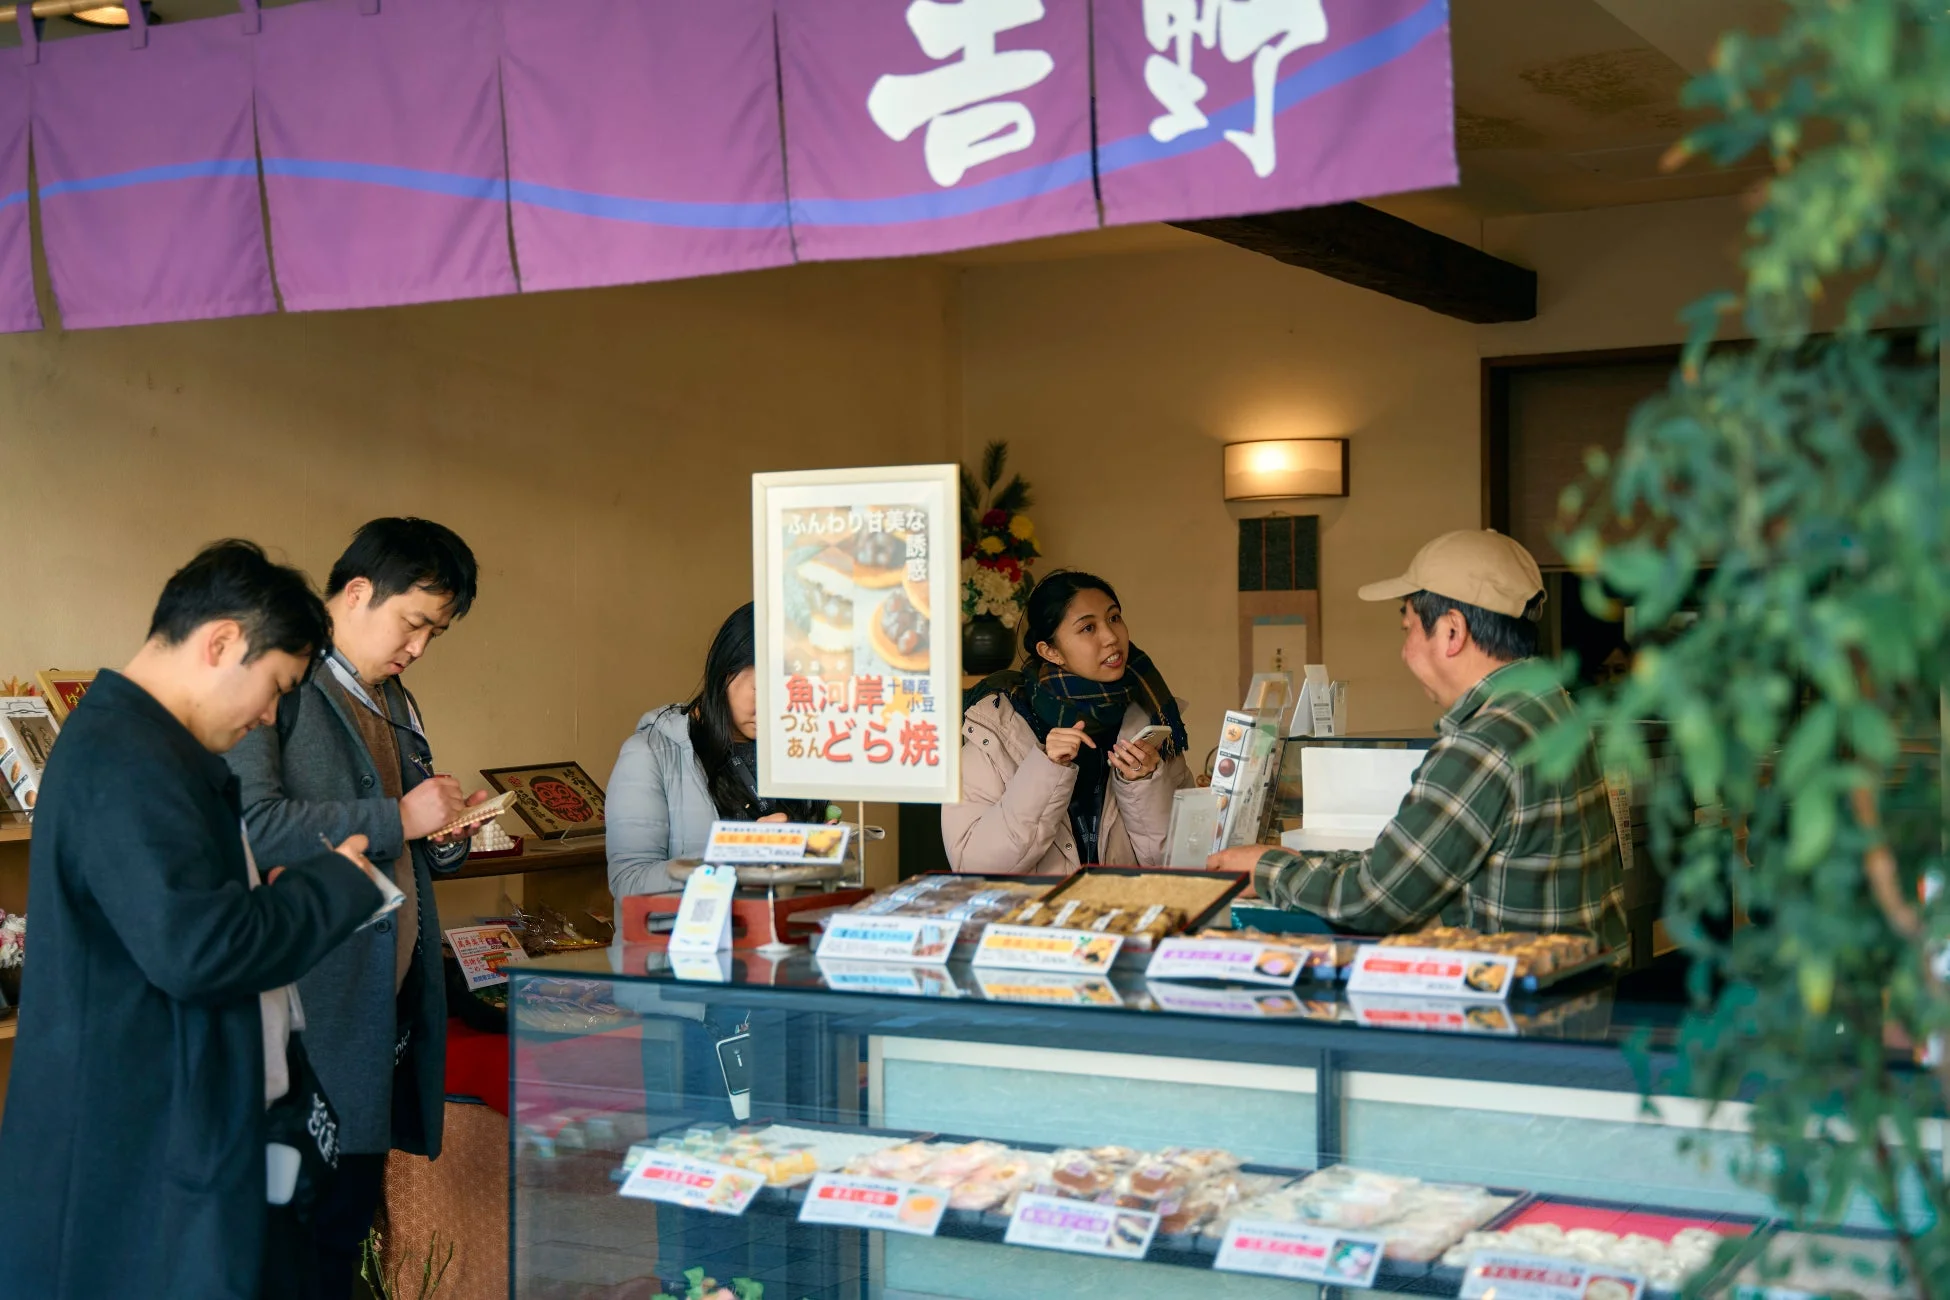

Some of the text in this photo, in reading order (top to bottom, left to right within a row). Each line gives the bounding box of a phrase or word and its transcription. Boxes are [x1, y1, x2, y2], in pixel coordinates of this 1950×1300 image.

[788, 509, 926, 534] ふんわり甘美な
[786, 673, 885, 713] 魚河岸
[906, 696, 935, 713] 小豆
[780, 713, 818, 733] つぶ
[787, 737, 824, 759] あん
[822, 718, 939, 766] どら焼
